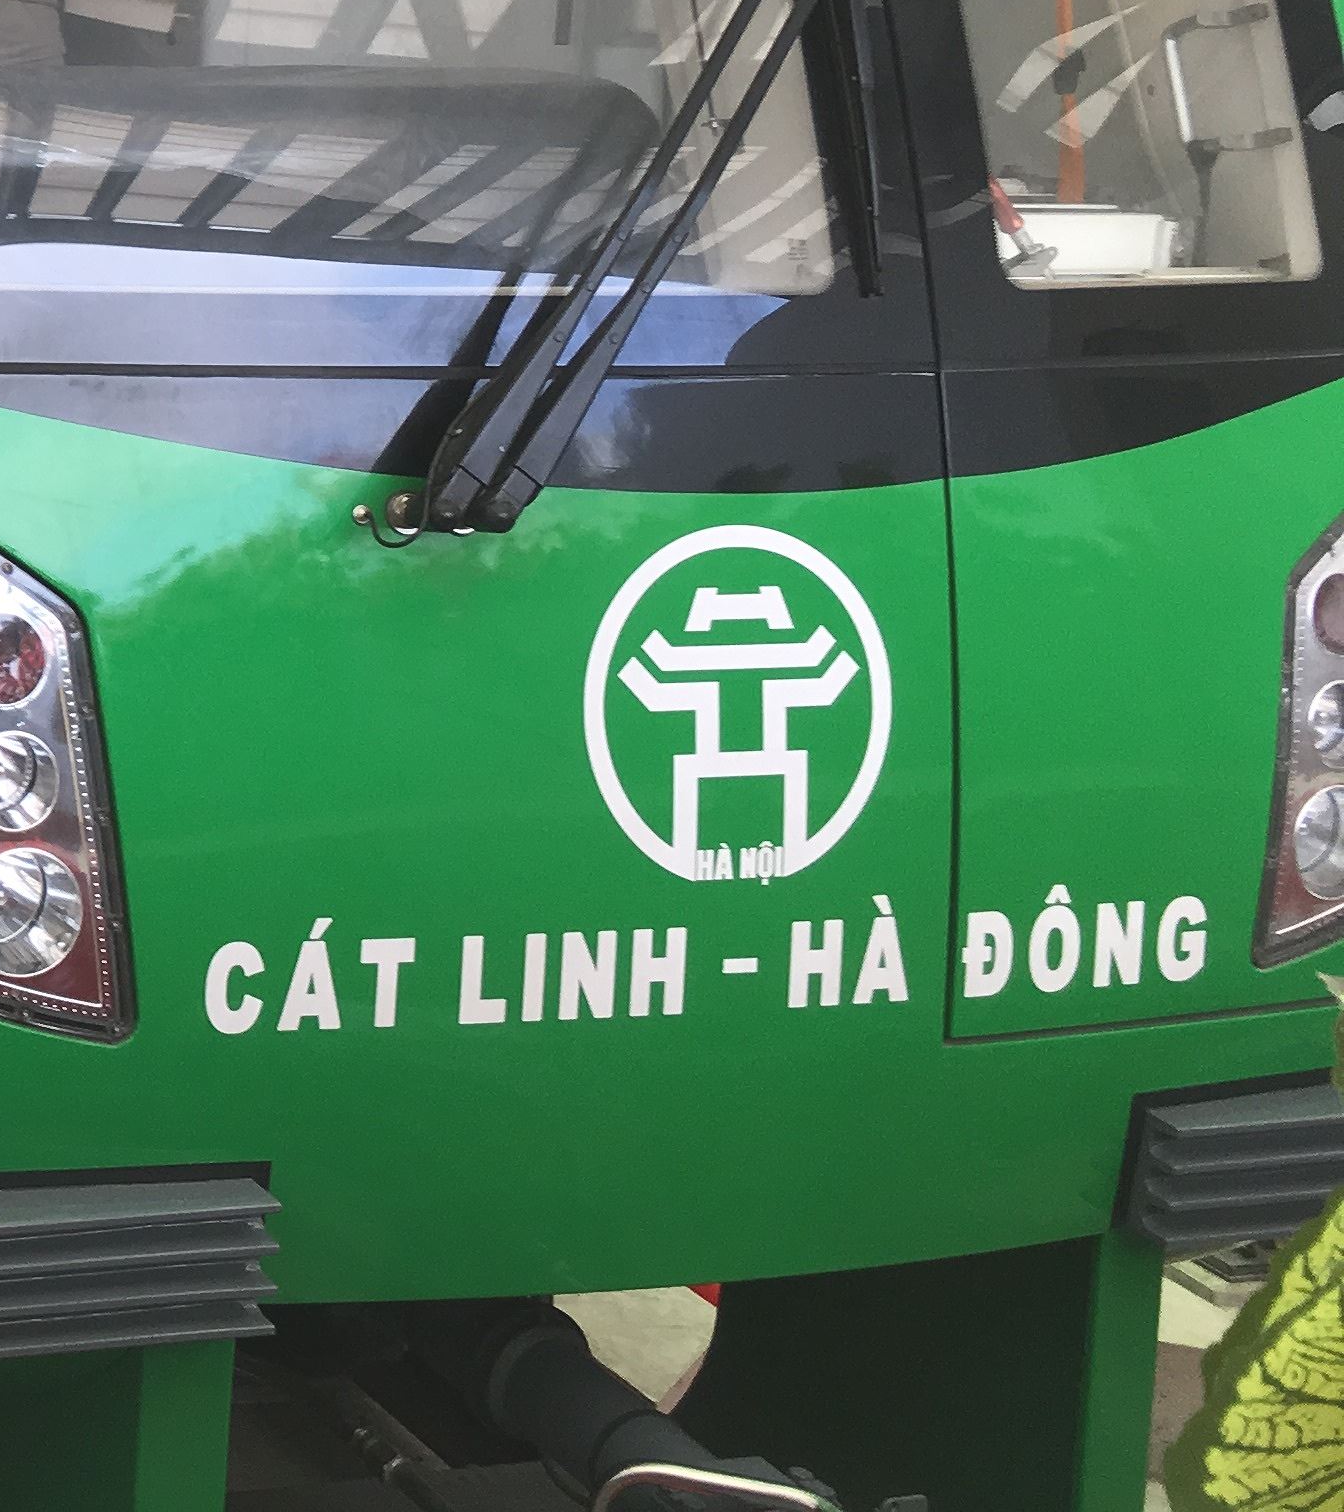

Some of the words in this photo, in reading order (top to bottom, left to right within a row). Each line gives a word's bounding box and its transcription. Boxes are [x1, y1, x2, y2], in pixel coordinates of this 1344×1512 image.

[696, 842, 735, 880] HÀ
[739, 840, 784, 886] NỘI
[204, 916, 416, 1035] CÁT
[458, 926, 688, 1025] LINH
[786, 894, 911, 1011] HÀ
[961, 883, 1210, 999] ĐÔNG
